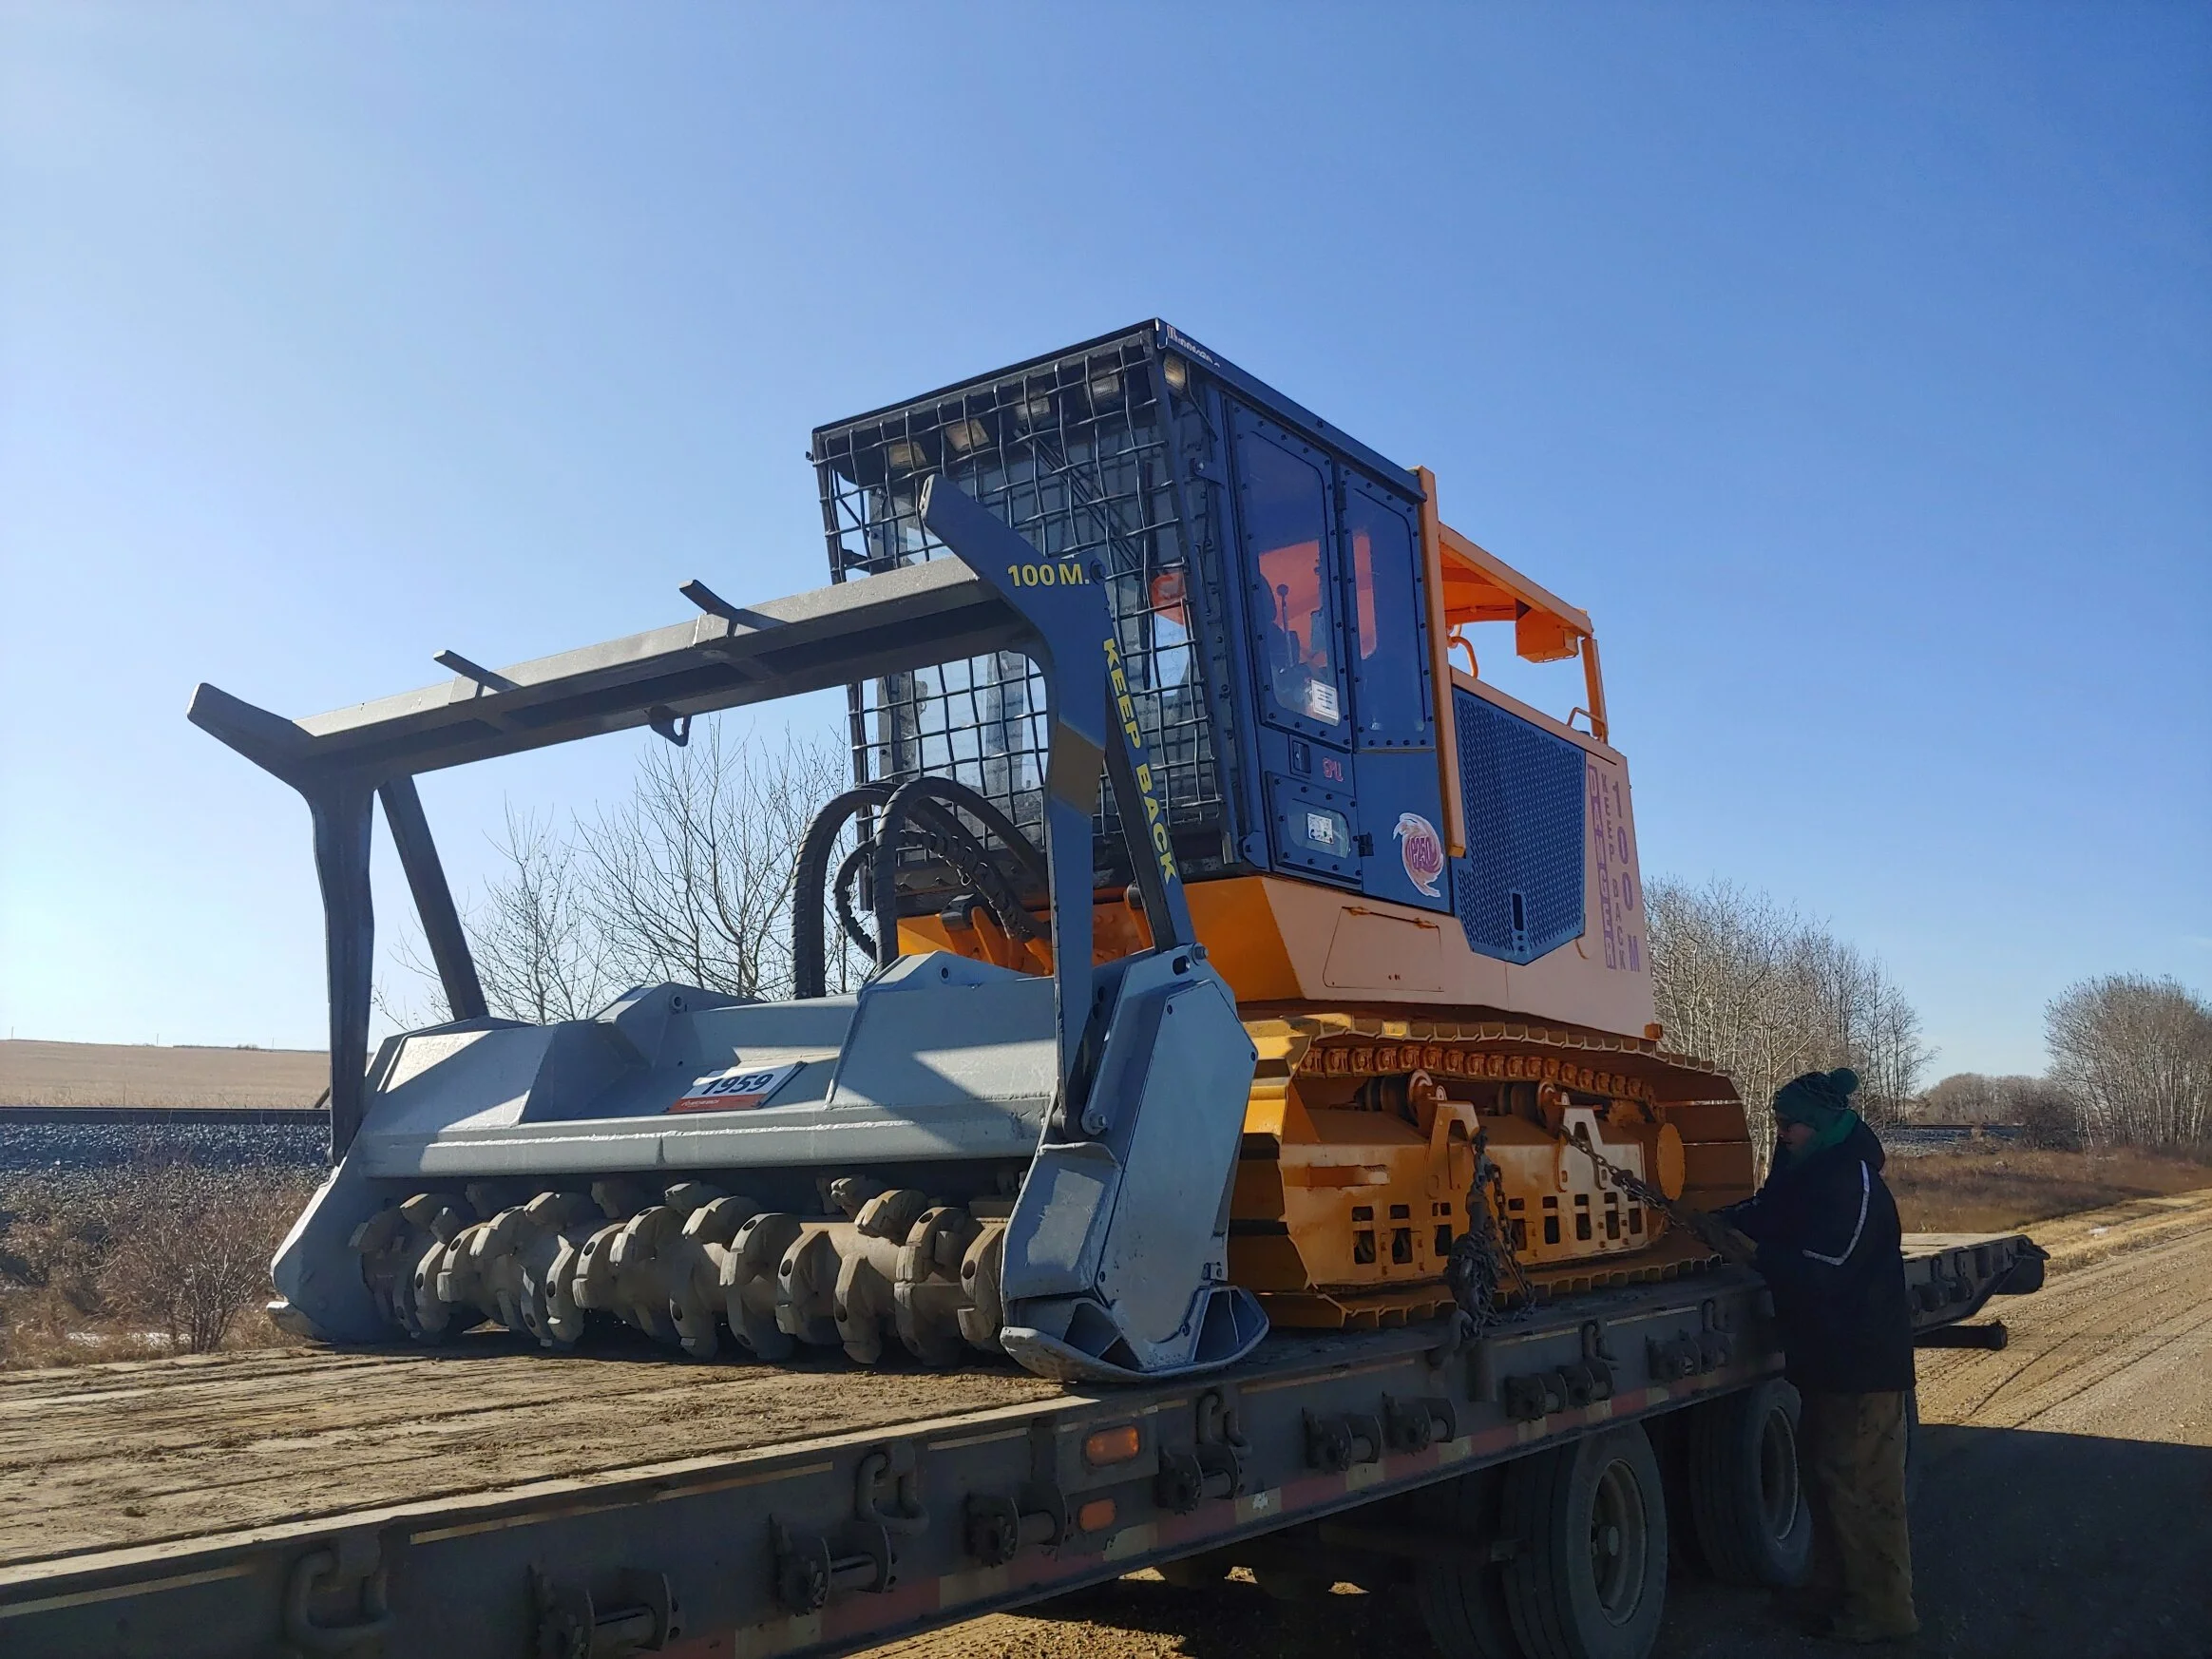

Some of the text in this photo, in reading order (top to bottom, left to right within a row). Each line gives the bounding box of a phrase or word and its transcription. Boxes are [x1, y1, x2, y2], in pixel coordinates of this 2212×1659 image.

[1007, 563, 1090, 587] 100 M.
[1103, 638, 1177, 885] KEEP BACK
[1587, 764, 1617, 970] DANGER
[1601, 772, 1627, 970] KEEP BACK
[1612, 780, 1641, 973] 100 M
[700, 1073, 774, 1096] 1959
